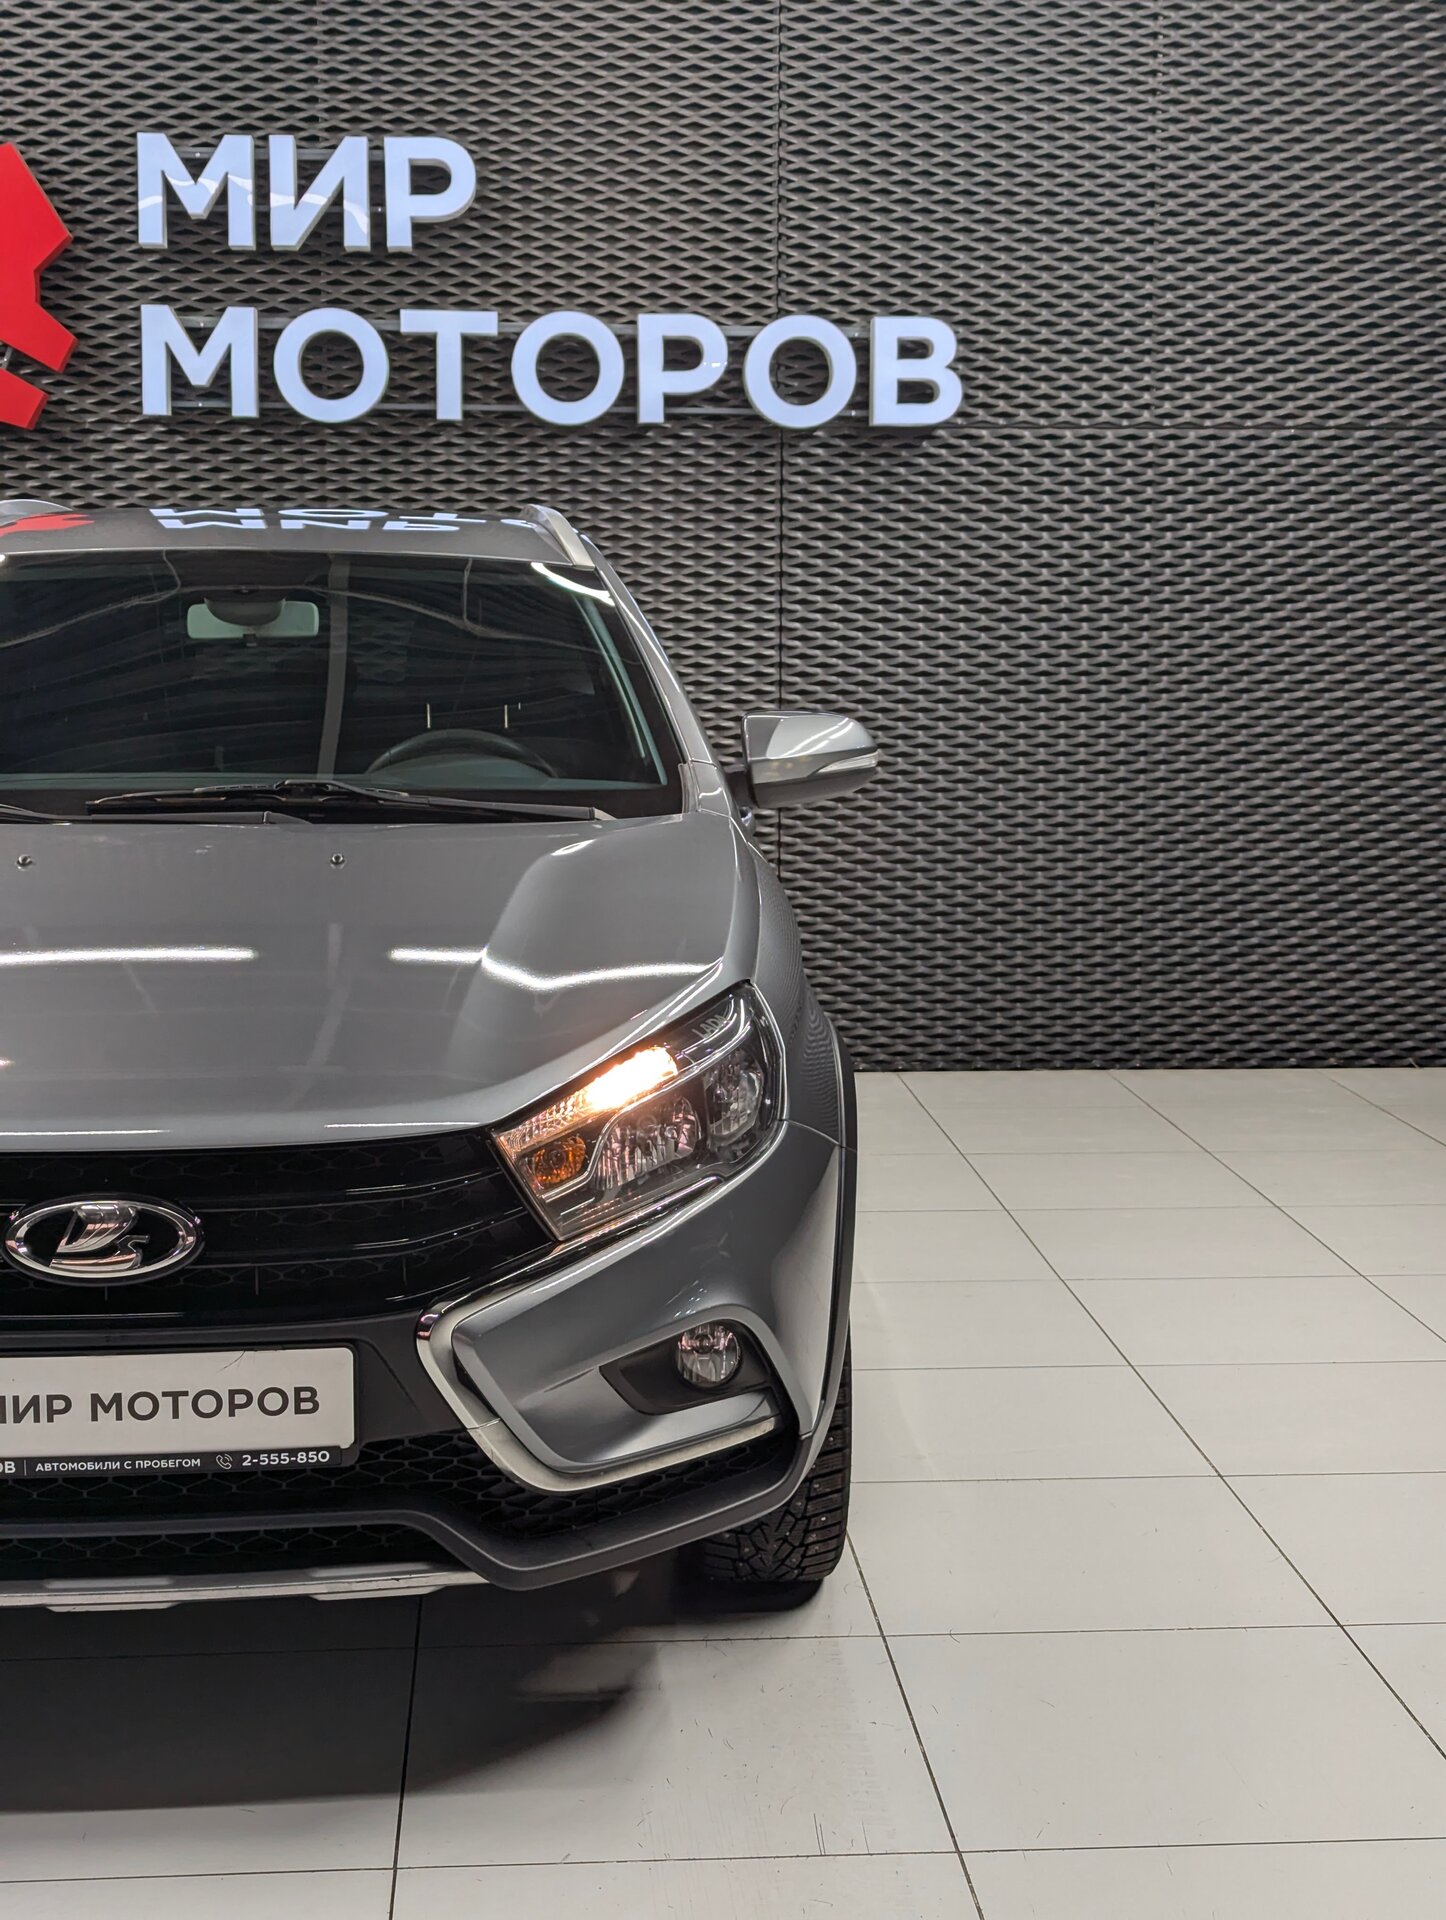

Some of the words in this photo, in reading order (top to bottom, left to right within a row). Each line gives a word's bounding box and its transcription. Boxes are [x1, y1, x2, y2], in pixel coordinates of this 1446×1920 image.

[136, 131, 478, 252] МИР
[140, 304, 963, 428] МОТОРОВ
[0, 1393, 73, 1424] ИР
[90, 1386, 320, 1422] МОТОРОВ
[0, 1461, 16, 1474] В
[35, 1461, 120, 1472] АВТОМОБИЛИ
[124, 1461, 132, 1469] С
[135, 1458, 201, 1469] ПРОБЕГОМ
[242, 1450, 330, 1466] 2-555-850
